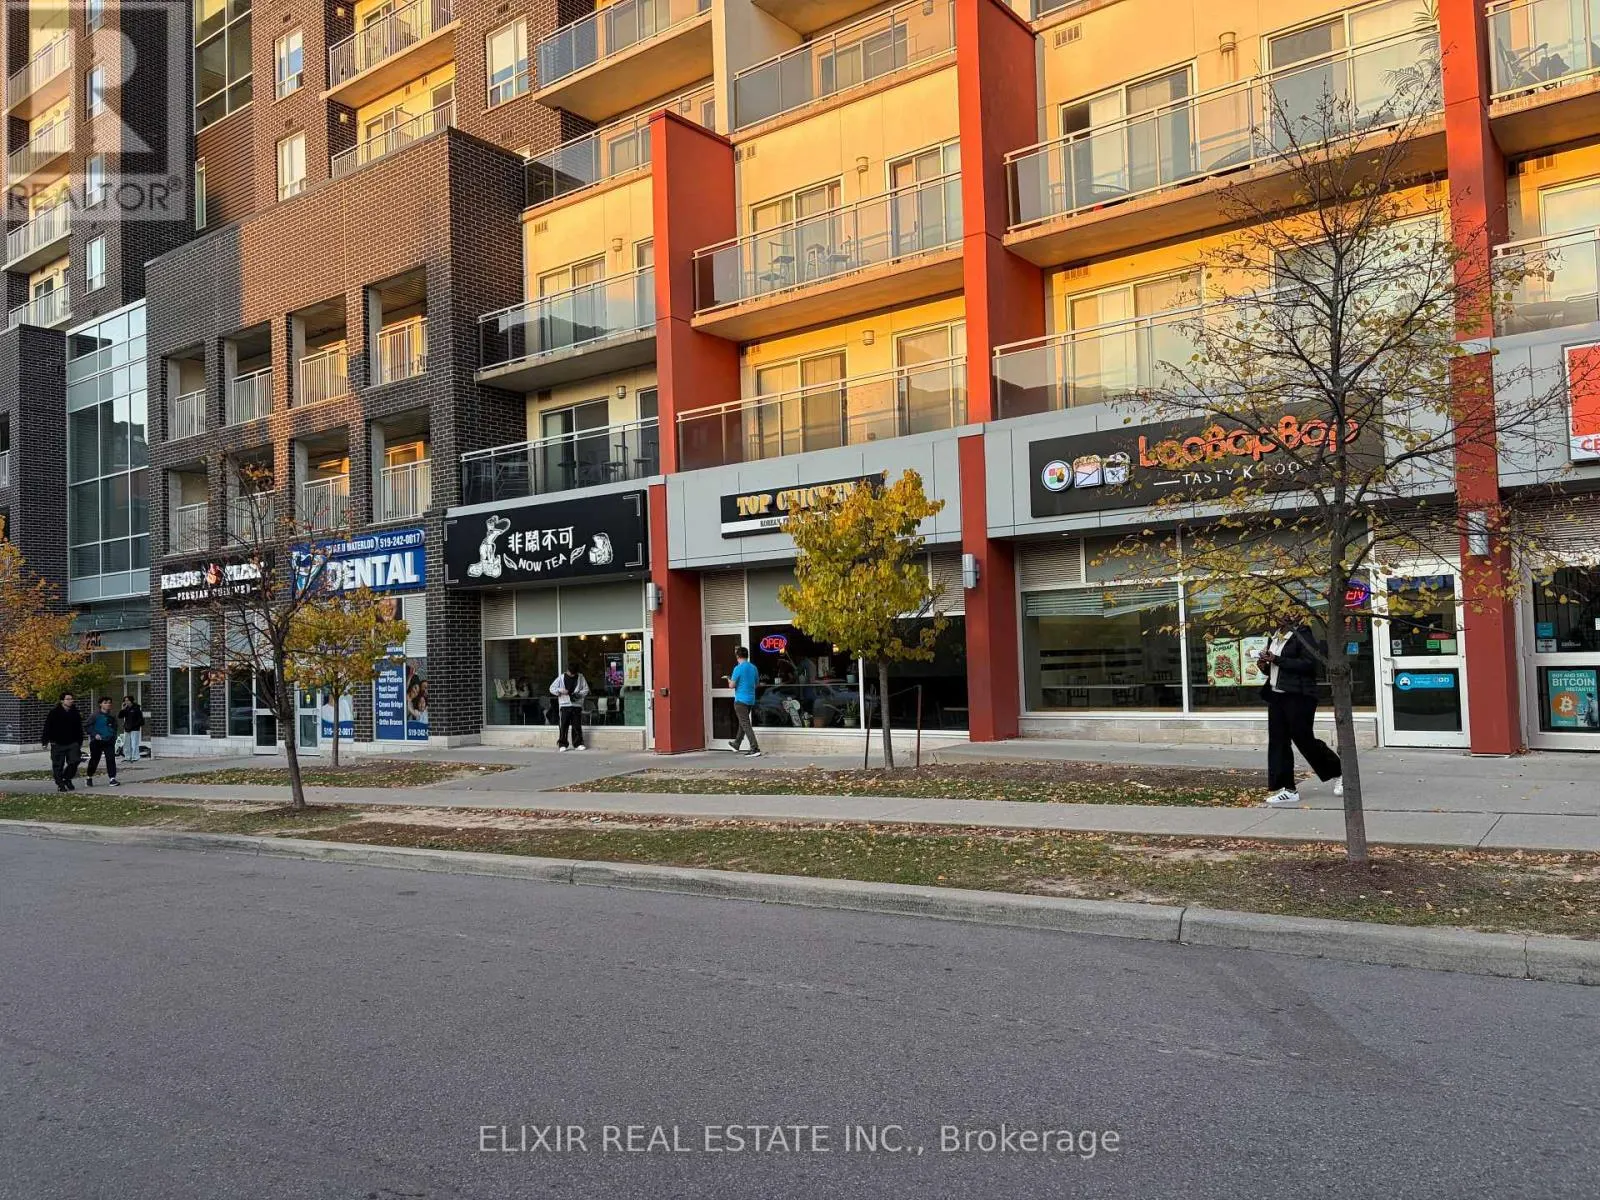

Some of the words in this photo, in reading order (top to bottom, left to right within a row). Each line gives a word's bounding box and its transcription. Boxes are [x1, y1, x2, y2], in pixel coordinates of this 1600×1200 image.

[1182, 469, 1234, 485] TASTY
[1243, 464, 1254, 479] K
[736, 494, 773, 516] TOP
[379, 533, 420, 549] 519-242-0017
[326, 551, 419, 591] DENTAL
[518, 557, 542, 572] NOW
[544, 553, 567, 570] TEA
[762, 638, 785, 649] OPEN
